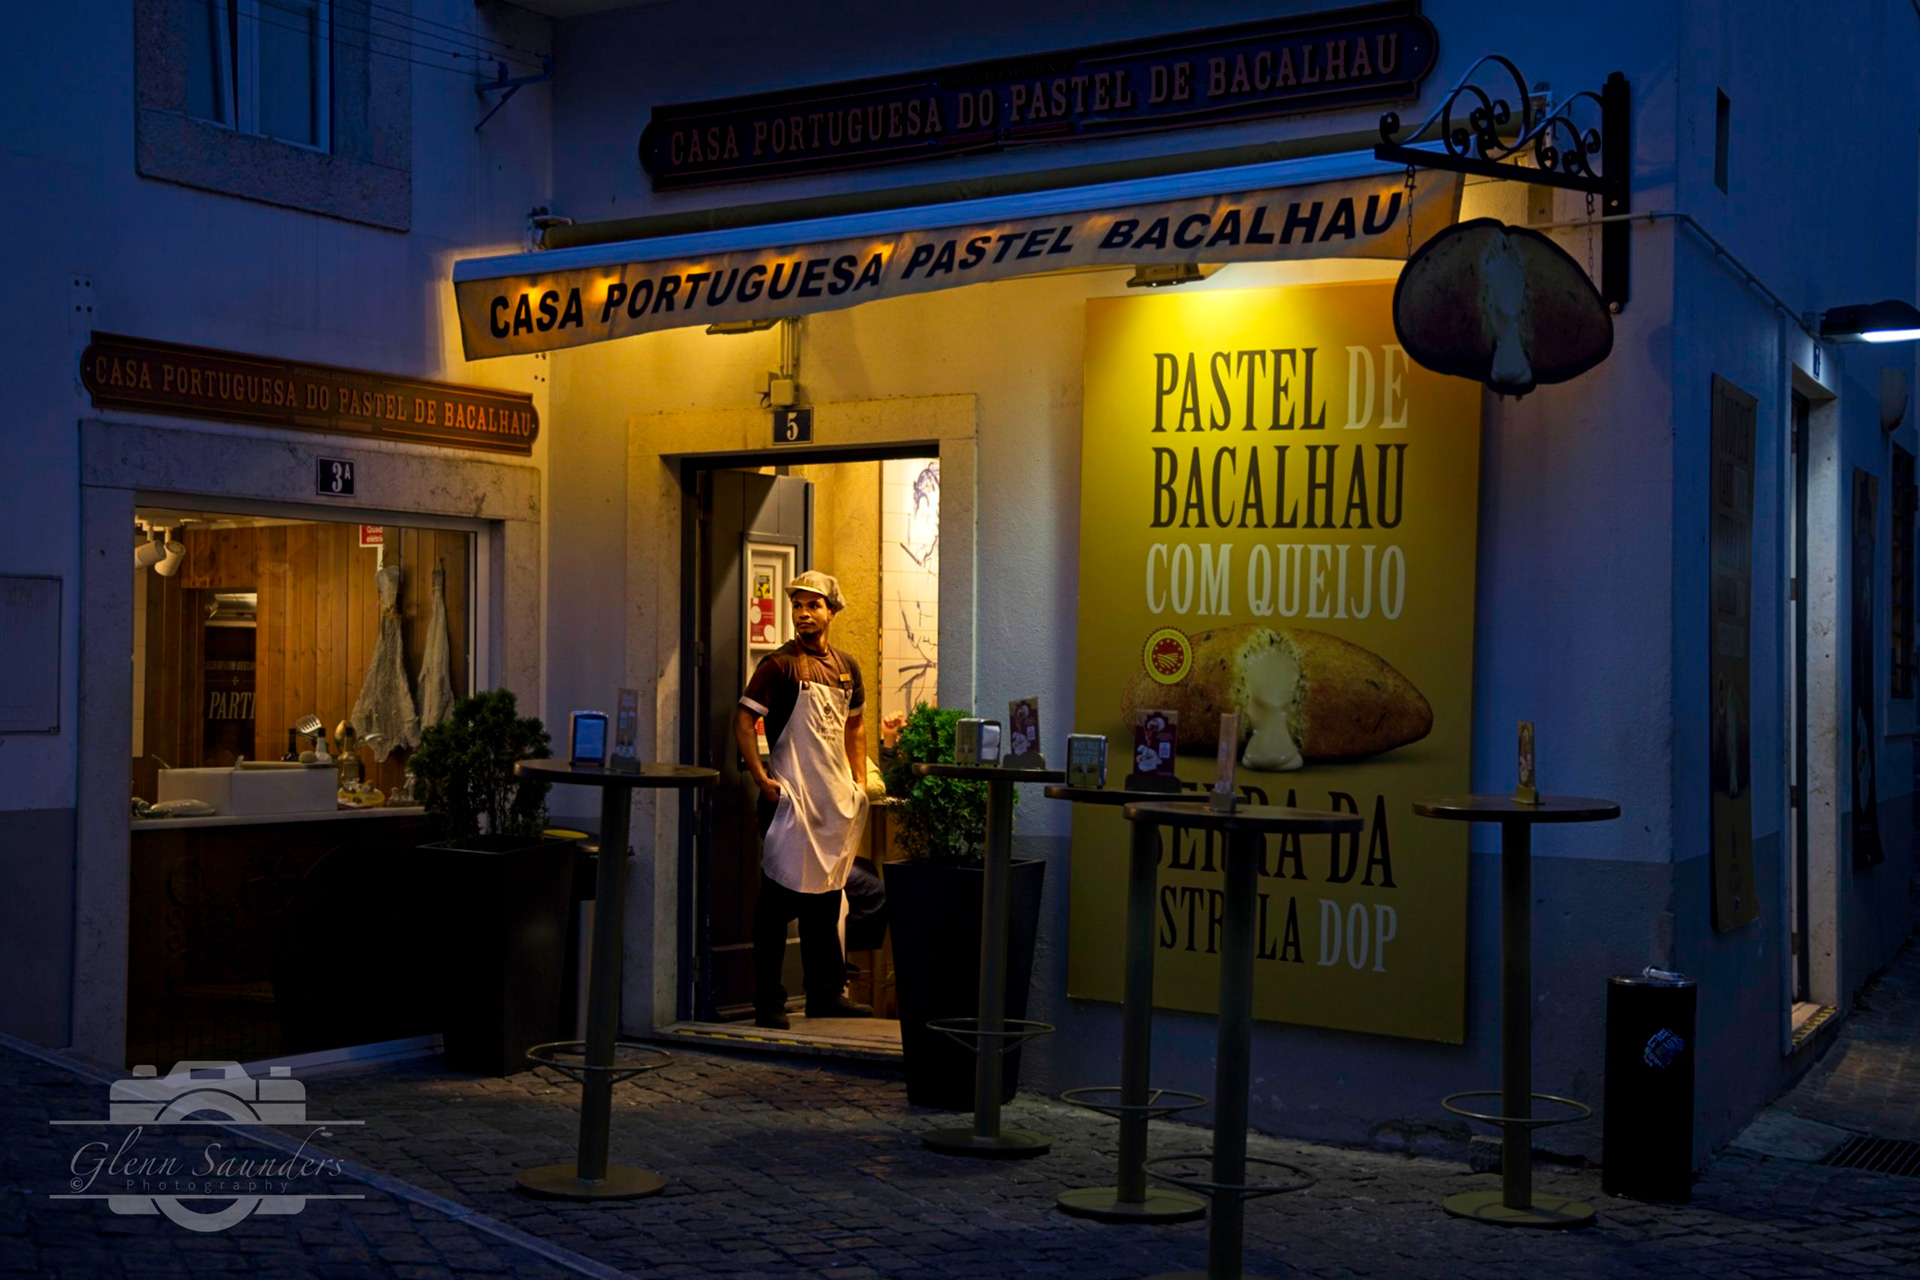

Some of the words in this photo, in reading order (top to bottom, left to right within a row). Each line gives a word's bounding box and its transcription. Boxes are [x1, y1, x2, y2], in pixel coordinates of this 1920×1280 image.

[670, 124, 741, 166] CASA
[752, 97, 943, 157] PORTUGUESA
[956, 87, 995, 131] DO
[1009, 69, 1132, 123] PASTEL
[1148, 60, 1191, 104] DE
[1207, 31, 1399, 97] BACALHAU
[489, 286, 585, 338] CASA
[600, 252, 884, 324] PORTUGUESA
[901, 226, 1074, 280] PASTEL
[1099, 191, 1403, 250] BACALHAU
[94, 355, 152, 392] CASA
[161, 363, 298, 408] PORTUGUESA
[305, 384, 330, 412] DO
[337, 388, 407, 421] PASTEL
[413, 398, 437, 425] DE
[443, 402, 532, 438] BACALHAU
[786, 410, 798, 441] 5
[1151, 347, 1327, 432] PASTEL
[1343, 344, 1410, 430] DE
[1149, 443, 1409, 529] BACALHAU
[1146, 543, 1234, 616] COM
[1247, 544, 1406, 620] QUEIJO
[1325, 791, 1398, 888] DA
[1159, 885, 1305, 964] STRLA
[1316, 899, 1398, 974] DOP
